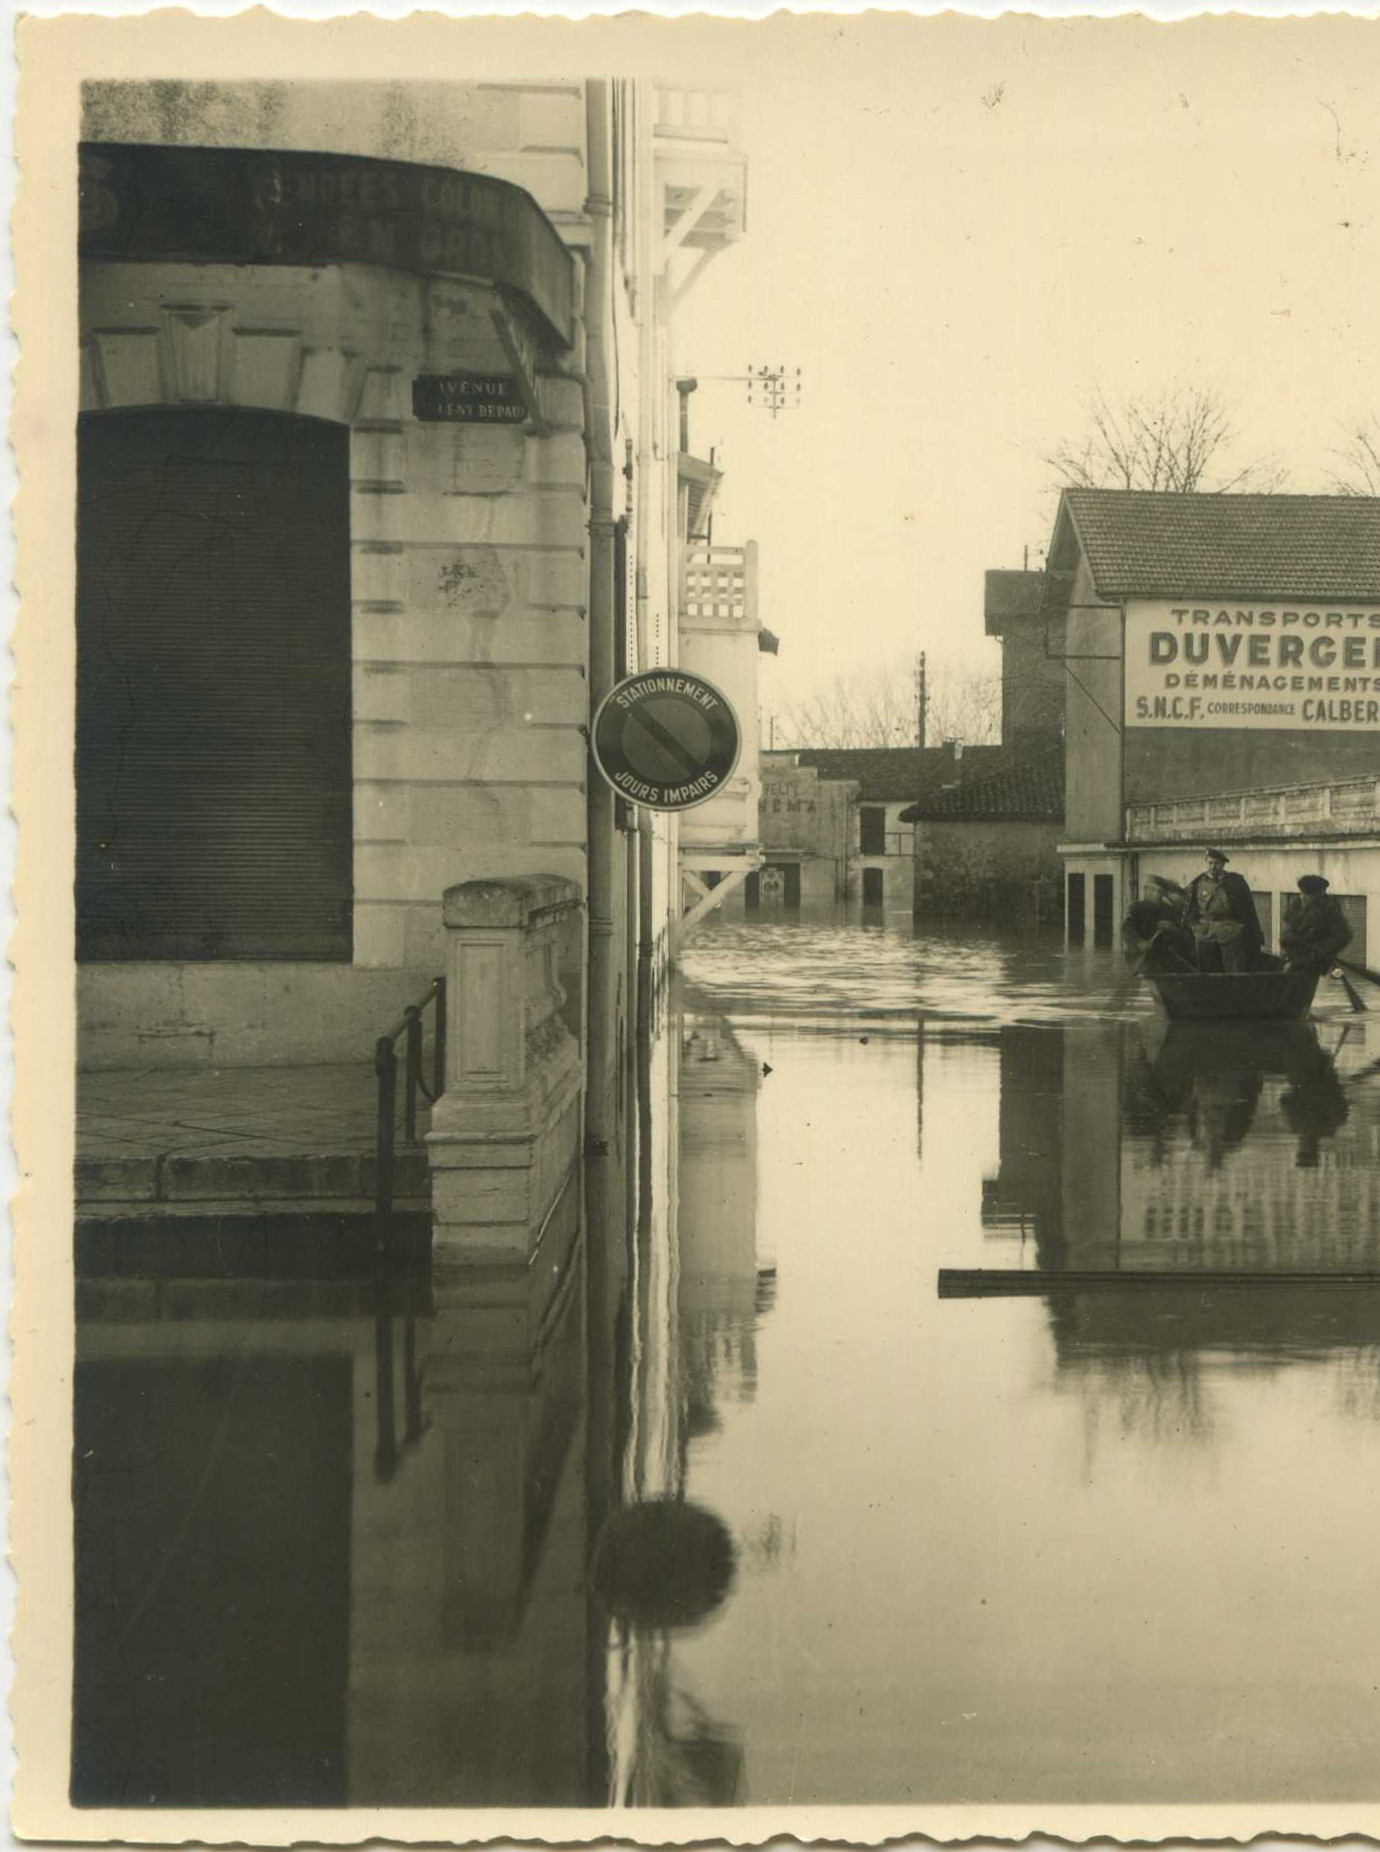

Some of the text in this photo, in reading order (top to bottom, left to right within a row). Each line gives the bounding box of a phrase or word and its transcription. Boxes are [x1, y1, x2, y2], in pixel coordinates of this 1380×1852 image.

[616, 677, 719, 710] STATIONNEMENT
[1136, 695, 1205, 721] S.N.C.F.
[1207, 701, 1296, 716] CORRESPONDANCE
[614, 770, 719, 804] JOURS IMPAIRS
